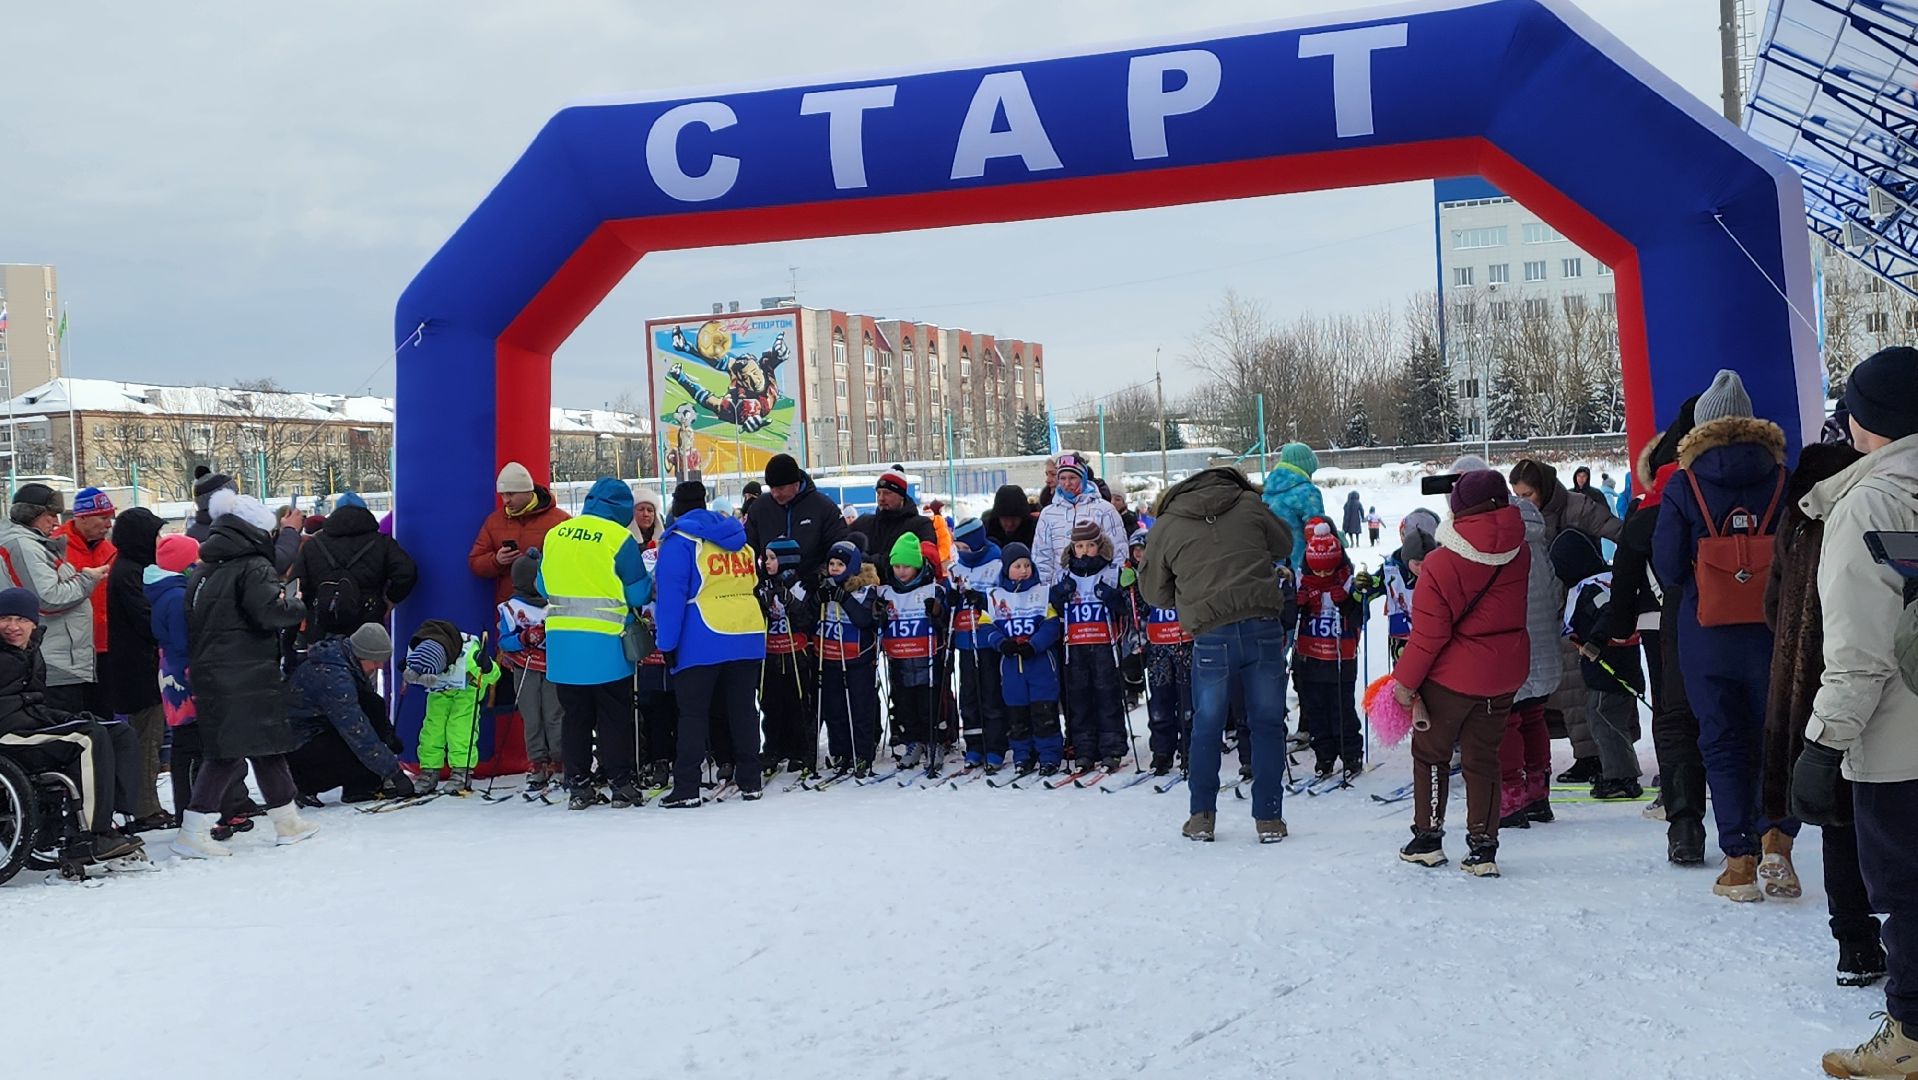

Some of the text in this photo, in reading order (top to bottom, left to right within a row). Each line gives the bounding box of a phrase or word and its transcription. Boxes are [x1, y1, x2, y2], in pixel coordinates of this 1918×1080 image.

[645, 22, 1409, 203] СТАРТ
[752, 319, 793, 330] СПОРТОМ
[558, 527, 603, 543] СУДЬЯ
[1072, 603, 1103, 622] 197
[888, 620, 921, 637] 157
[1004, 619, 1035, 637] 155
